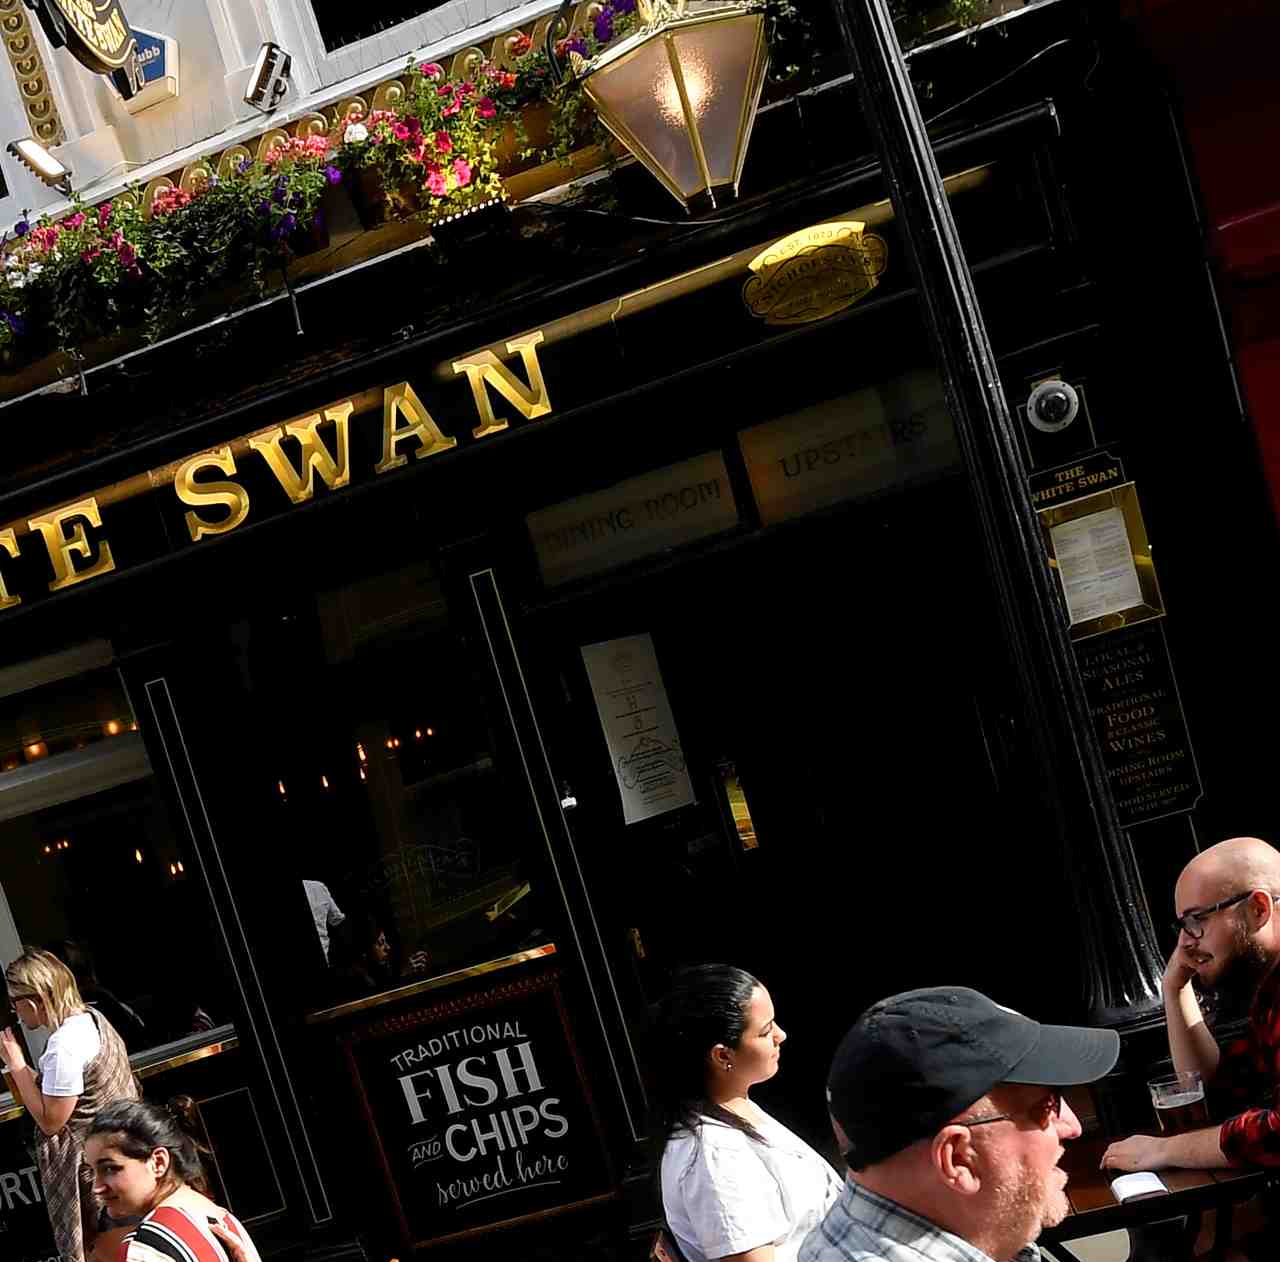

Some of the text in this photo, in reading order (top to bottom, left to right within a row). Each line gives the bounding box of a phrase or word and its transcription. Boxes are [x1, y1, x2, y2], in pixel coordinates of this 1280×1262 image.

[174, 330, 552, 541] SWAN
[1029, 466, 1120, 504] WHITE SWAN
[1054, 464, 1086, 482] THE
[644, 479, 721, 521] ROOM
[1102, 672, 1144, 690] ALES
[1107, 706, 1156, 728] FOOD
[1108, 730, 1167, 752] WINES
[389, 1020, 528, 1072] TRADITIONAL
[396, 1040, 547, 1126] FISH
[411, 1097, 569, 1163] AND CHIPS
[434, 1150, 569, 1206] served here
